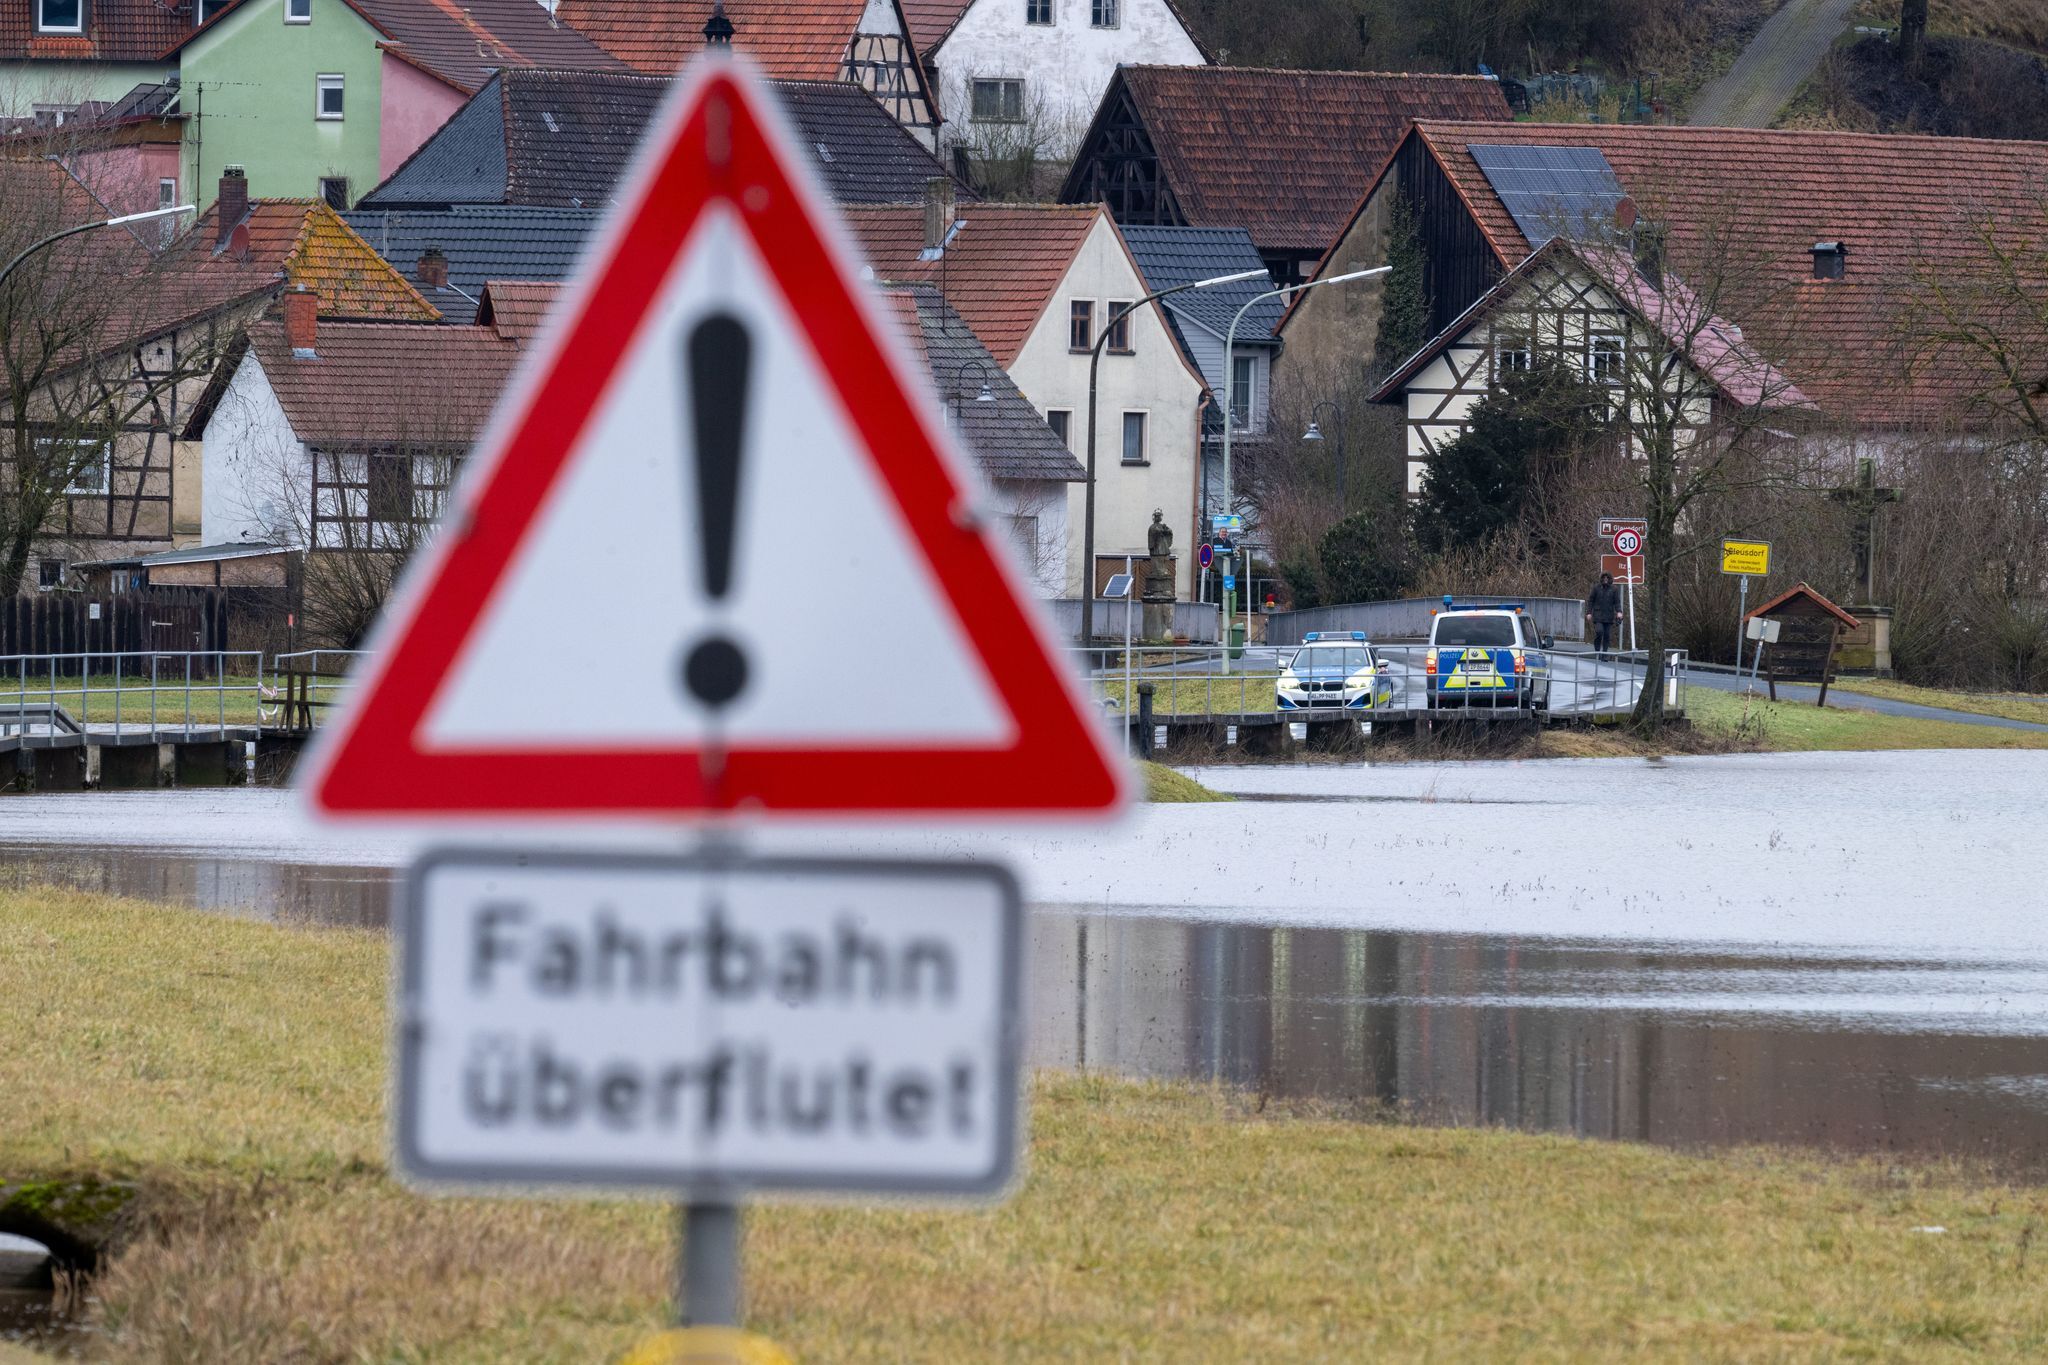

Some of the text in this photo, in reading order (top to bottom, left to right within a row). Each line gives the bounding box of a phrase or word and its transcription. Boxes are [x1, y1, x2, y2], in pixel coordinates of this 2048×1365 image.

[1619, 536, 1636, 550] 30
[468, 899, 956, 1001] Fahrbahn
[463, 1031, 976, 1140] überflutet
